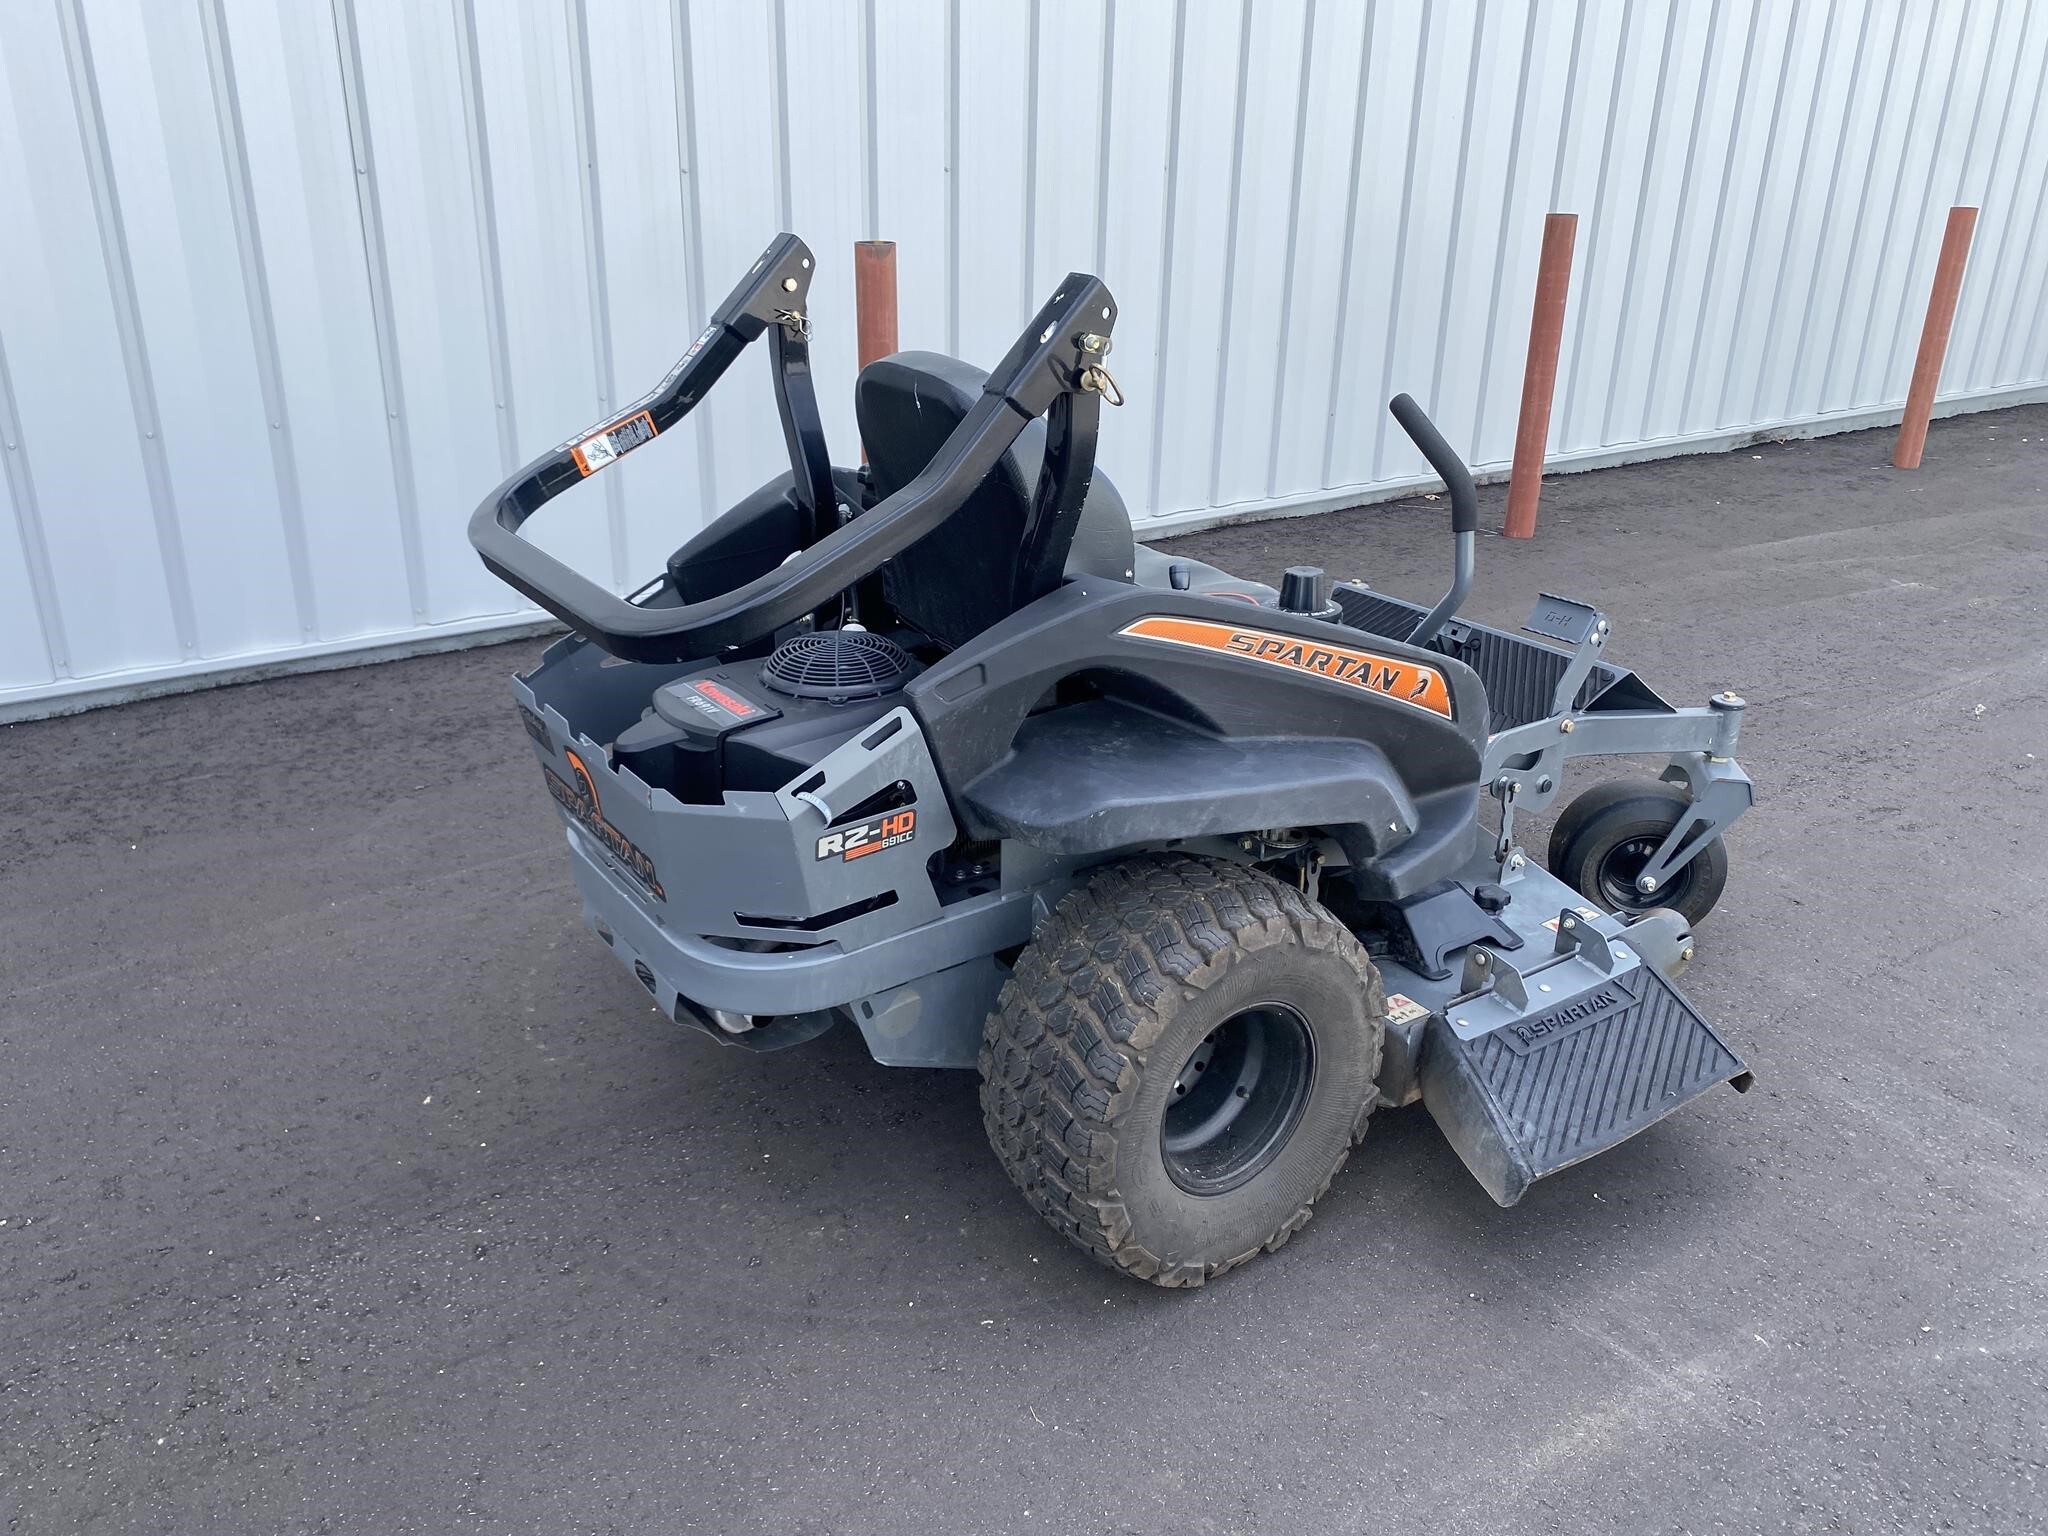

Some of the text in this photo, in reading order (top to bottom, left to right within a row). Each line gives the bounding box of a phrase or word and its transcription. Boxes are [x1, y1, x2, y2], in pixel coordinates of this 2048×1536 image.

[1226, 632, 1401, 692] SPARTAN
[694, 679, 757, 716] Kawasaki
[817, 810, 915, 858] RZ-HD
[881, 830, 913, 849] 691CC
[1530, 991, 1617, 1037] SPARTAN
